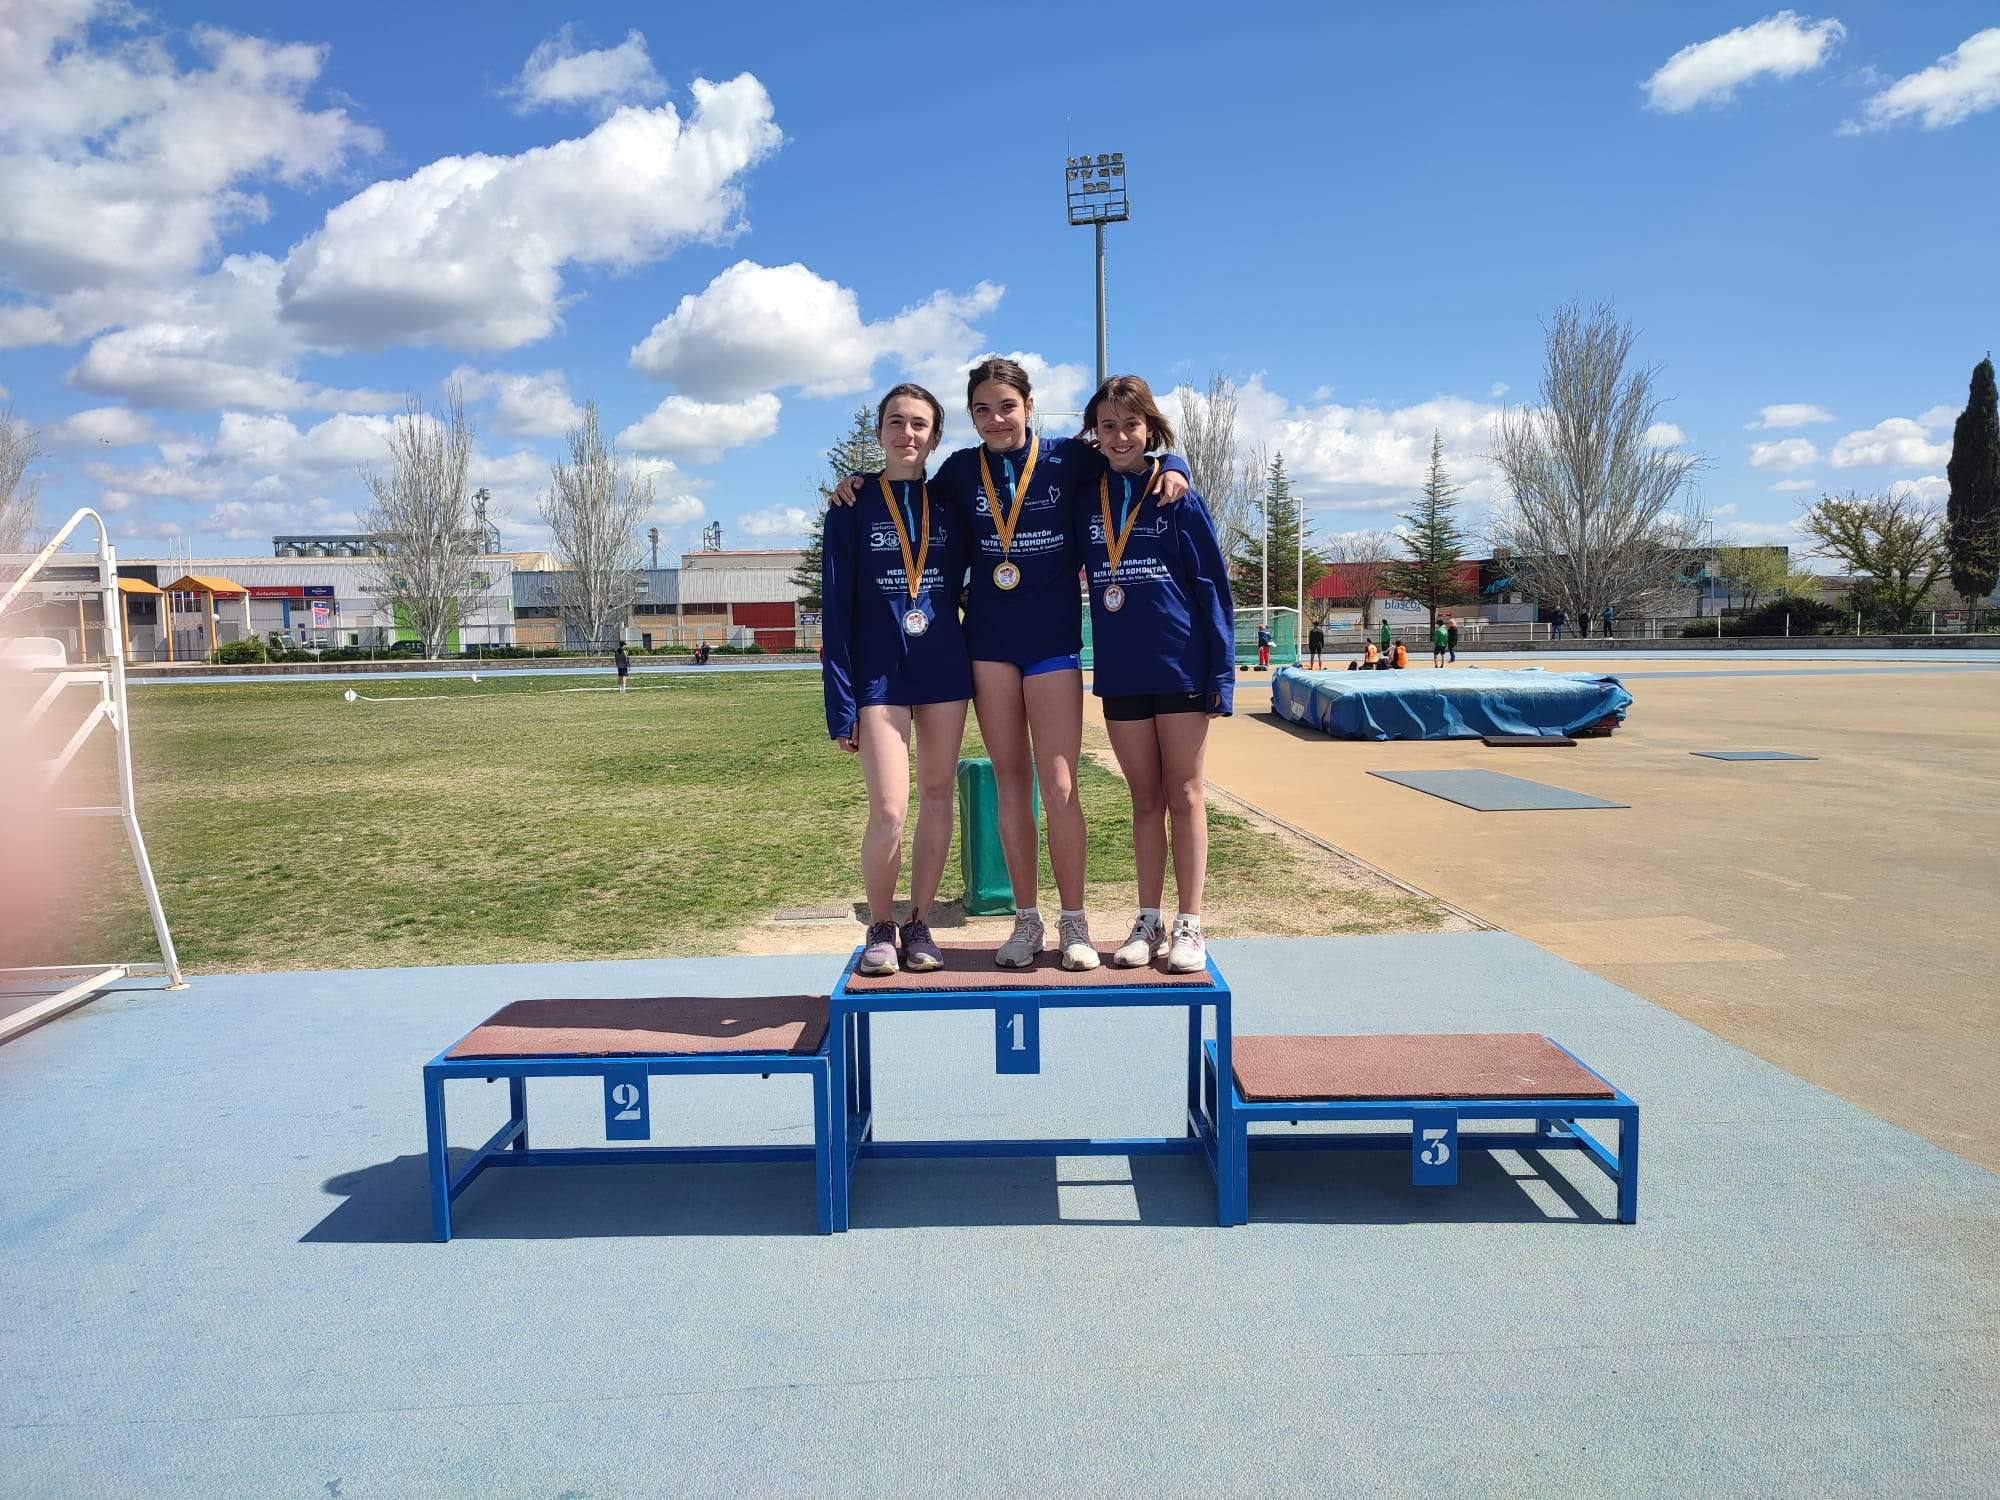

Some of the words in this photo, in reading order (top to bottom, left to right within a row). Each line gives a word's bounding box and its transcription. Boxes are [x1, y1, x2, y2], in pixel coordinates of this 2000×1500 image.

[1016, 530, 1052, 539] MARATÓN
[1019, 534, 1064, 547] SOMONTANO
[1123, 557, 1156, 566] MARATÓN
[1384, 600, 1418, 610] blasco
[1007, 1013, 1026, 1050] 1
[612, 1083, 641, 1120] 2
[1420, 1128, 1450, 1166] 3
